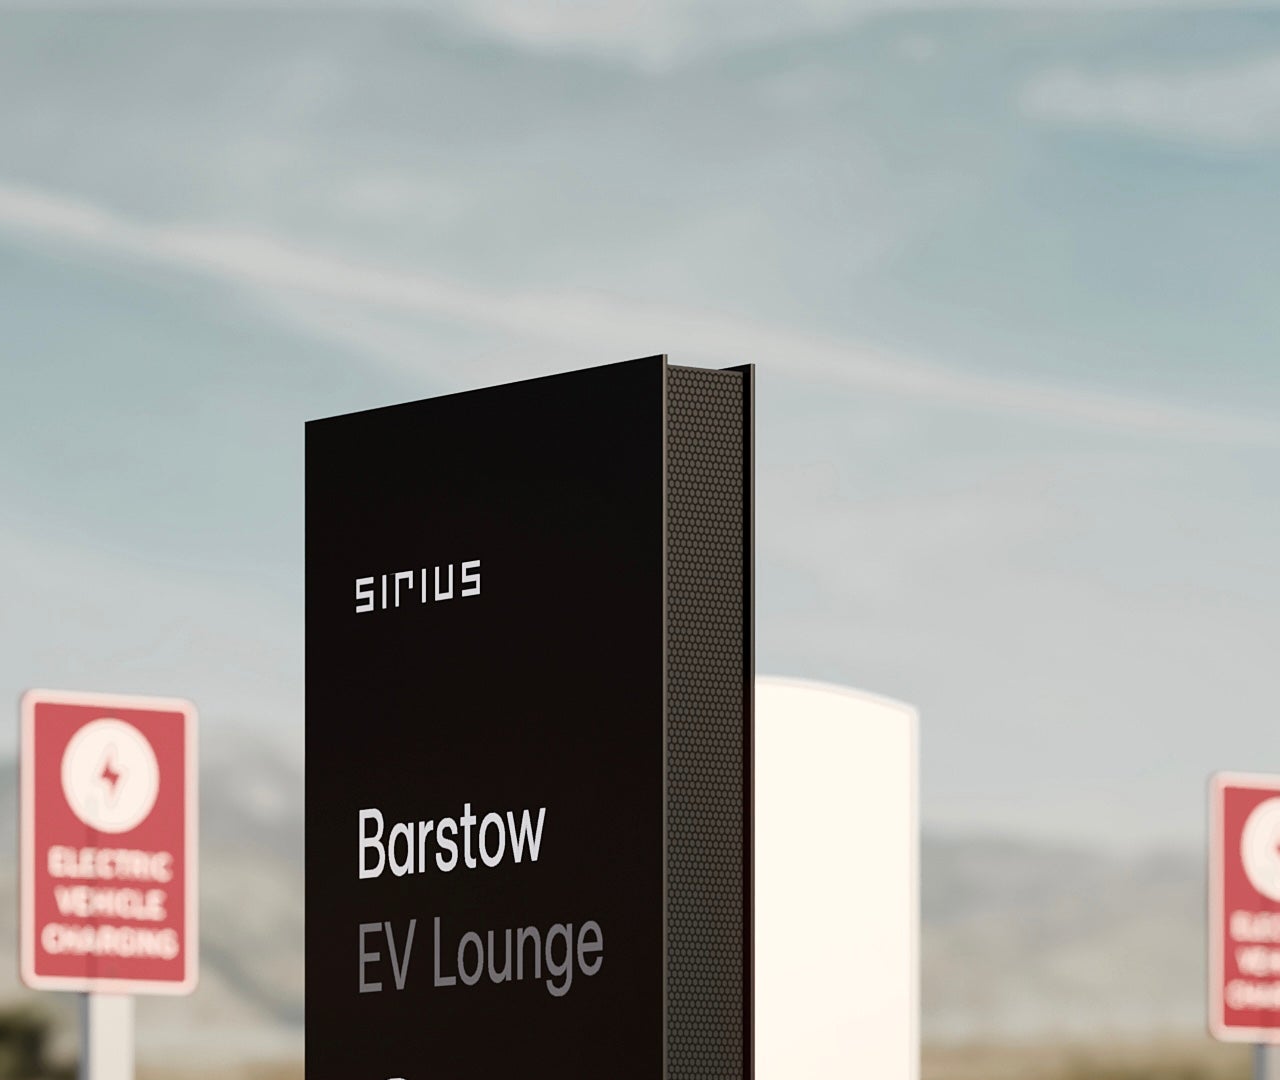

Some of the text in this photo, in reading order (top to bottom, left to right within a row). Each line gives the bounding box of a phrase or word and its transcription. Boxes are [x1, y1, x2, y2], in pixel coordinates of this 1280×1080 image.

[358, 802, 547, 880] Barstow
[47, 845, 173, 883] ELECTRIC
[54, 885, 167, 921] VEHICLE
[41, 922, 179, 960] CHARGING
[359, 916, 604, 997] EV Lounge
